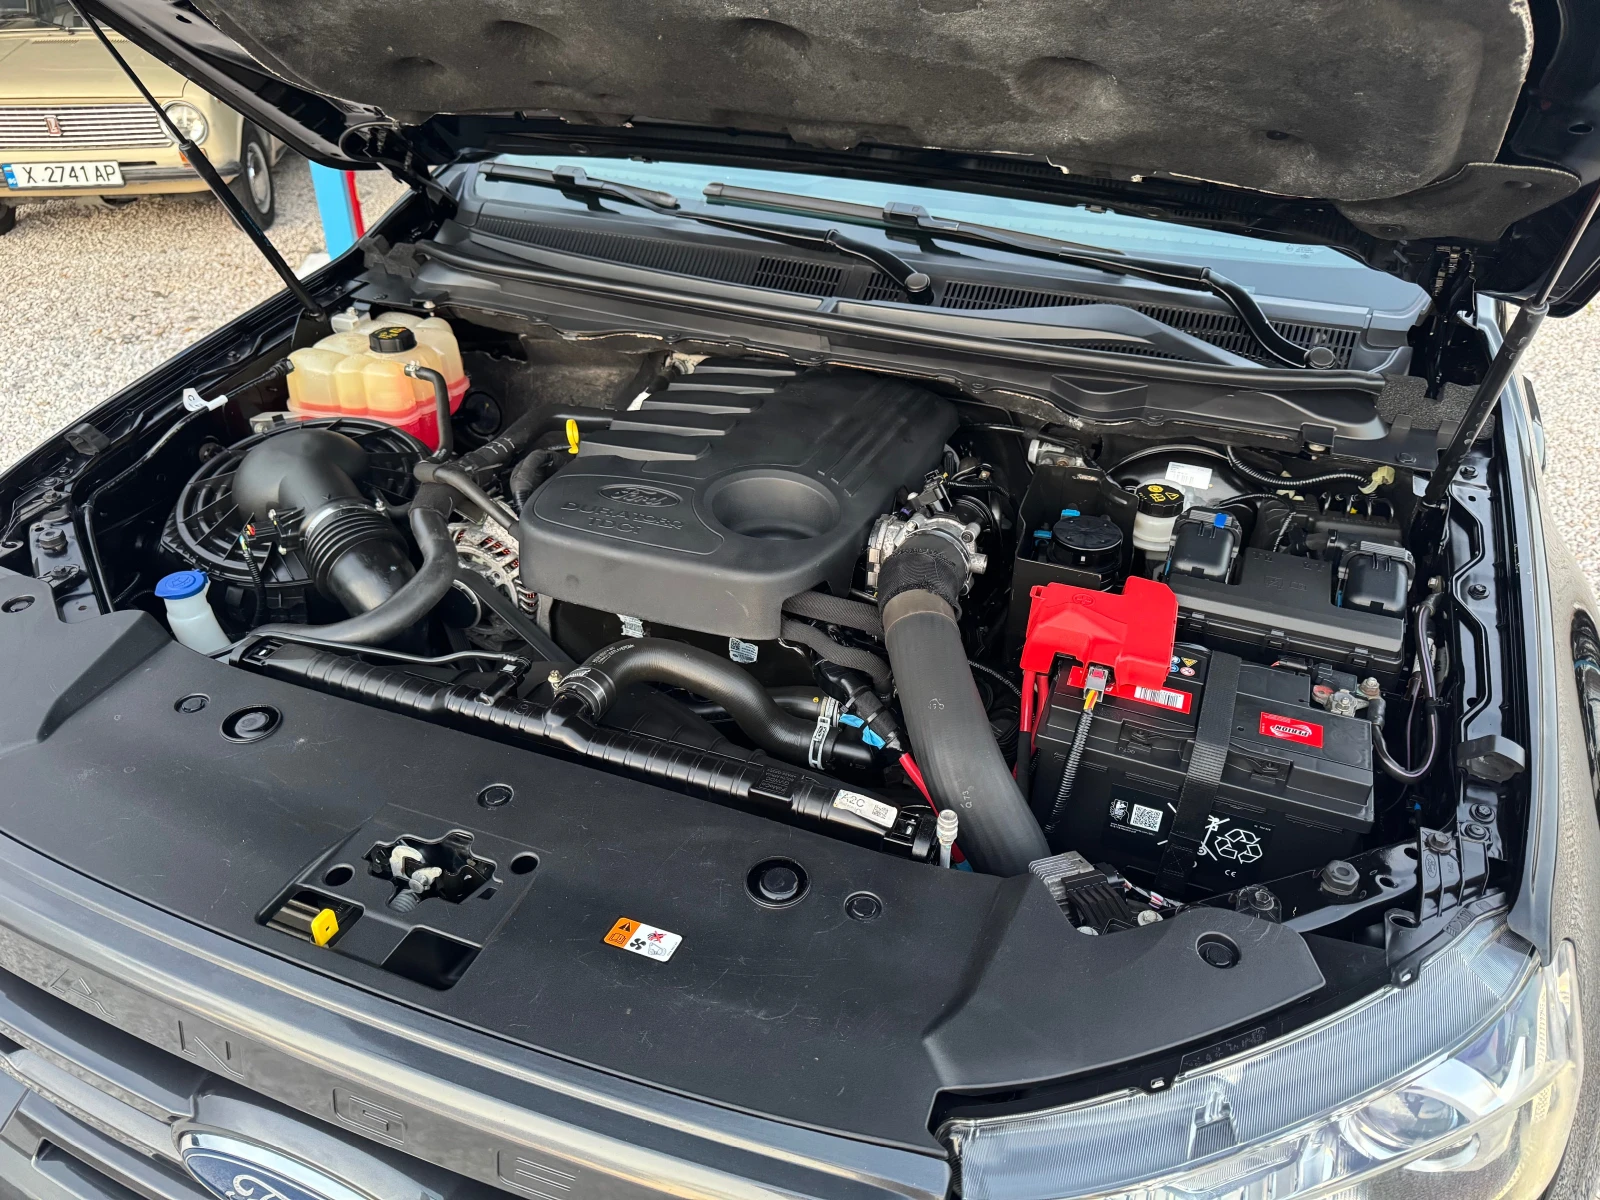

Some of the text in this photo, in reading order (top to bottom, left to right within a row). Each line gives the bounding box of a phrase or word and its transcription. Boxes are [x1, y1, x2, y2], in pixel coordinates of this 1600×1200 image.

[611, 487, 667, 506] Ford
[560, 502, 684, 530] DURATORQ
[1275, 725, 1308, 737] PERION
[840, 793, 866, 808] A2C
